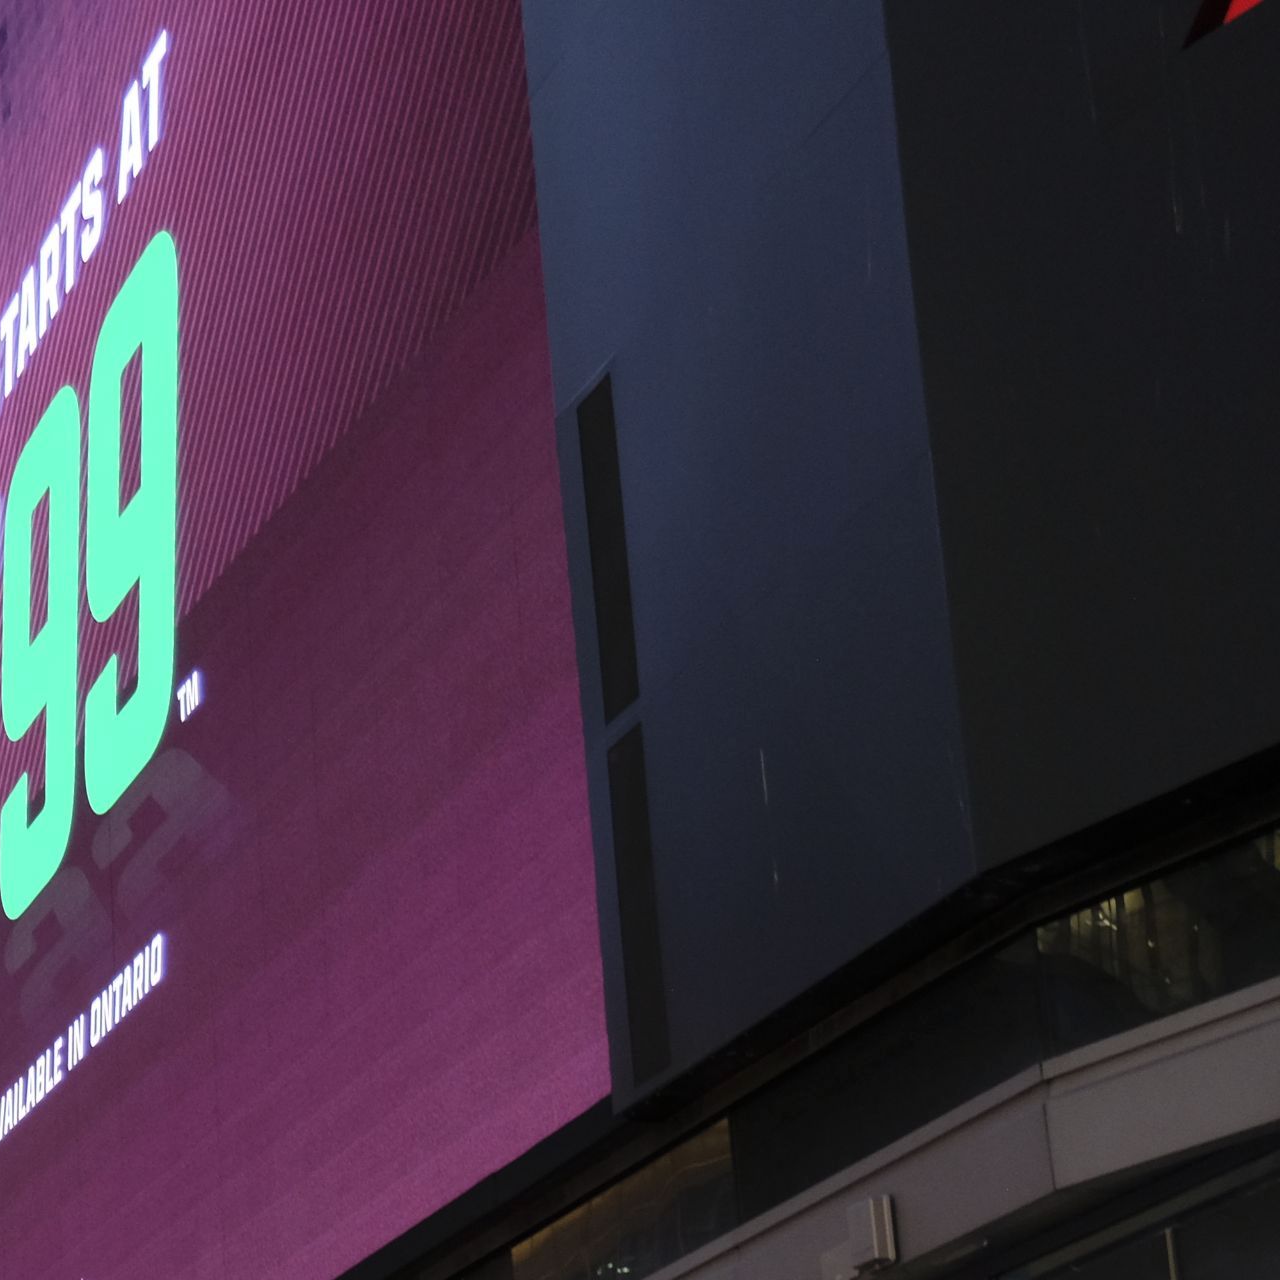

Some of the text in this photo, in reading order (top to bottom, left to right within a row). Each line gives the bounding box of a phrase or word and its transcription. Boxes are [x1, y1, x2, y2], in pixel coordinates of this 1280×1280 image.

[118, 28, 167, 205] AT
[67, 1014, 85, 1071] IN
[90, 933, 163, 1047] ONTARIO
